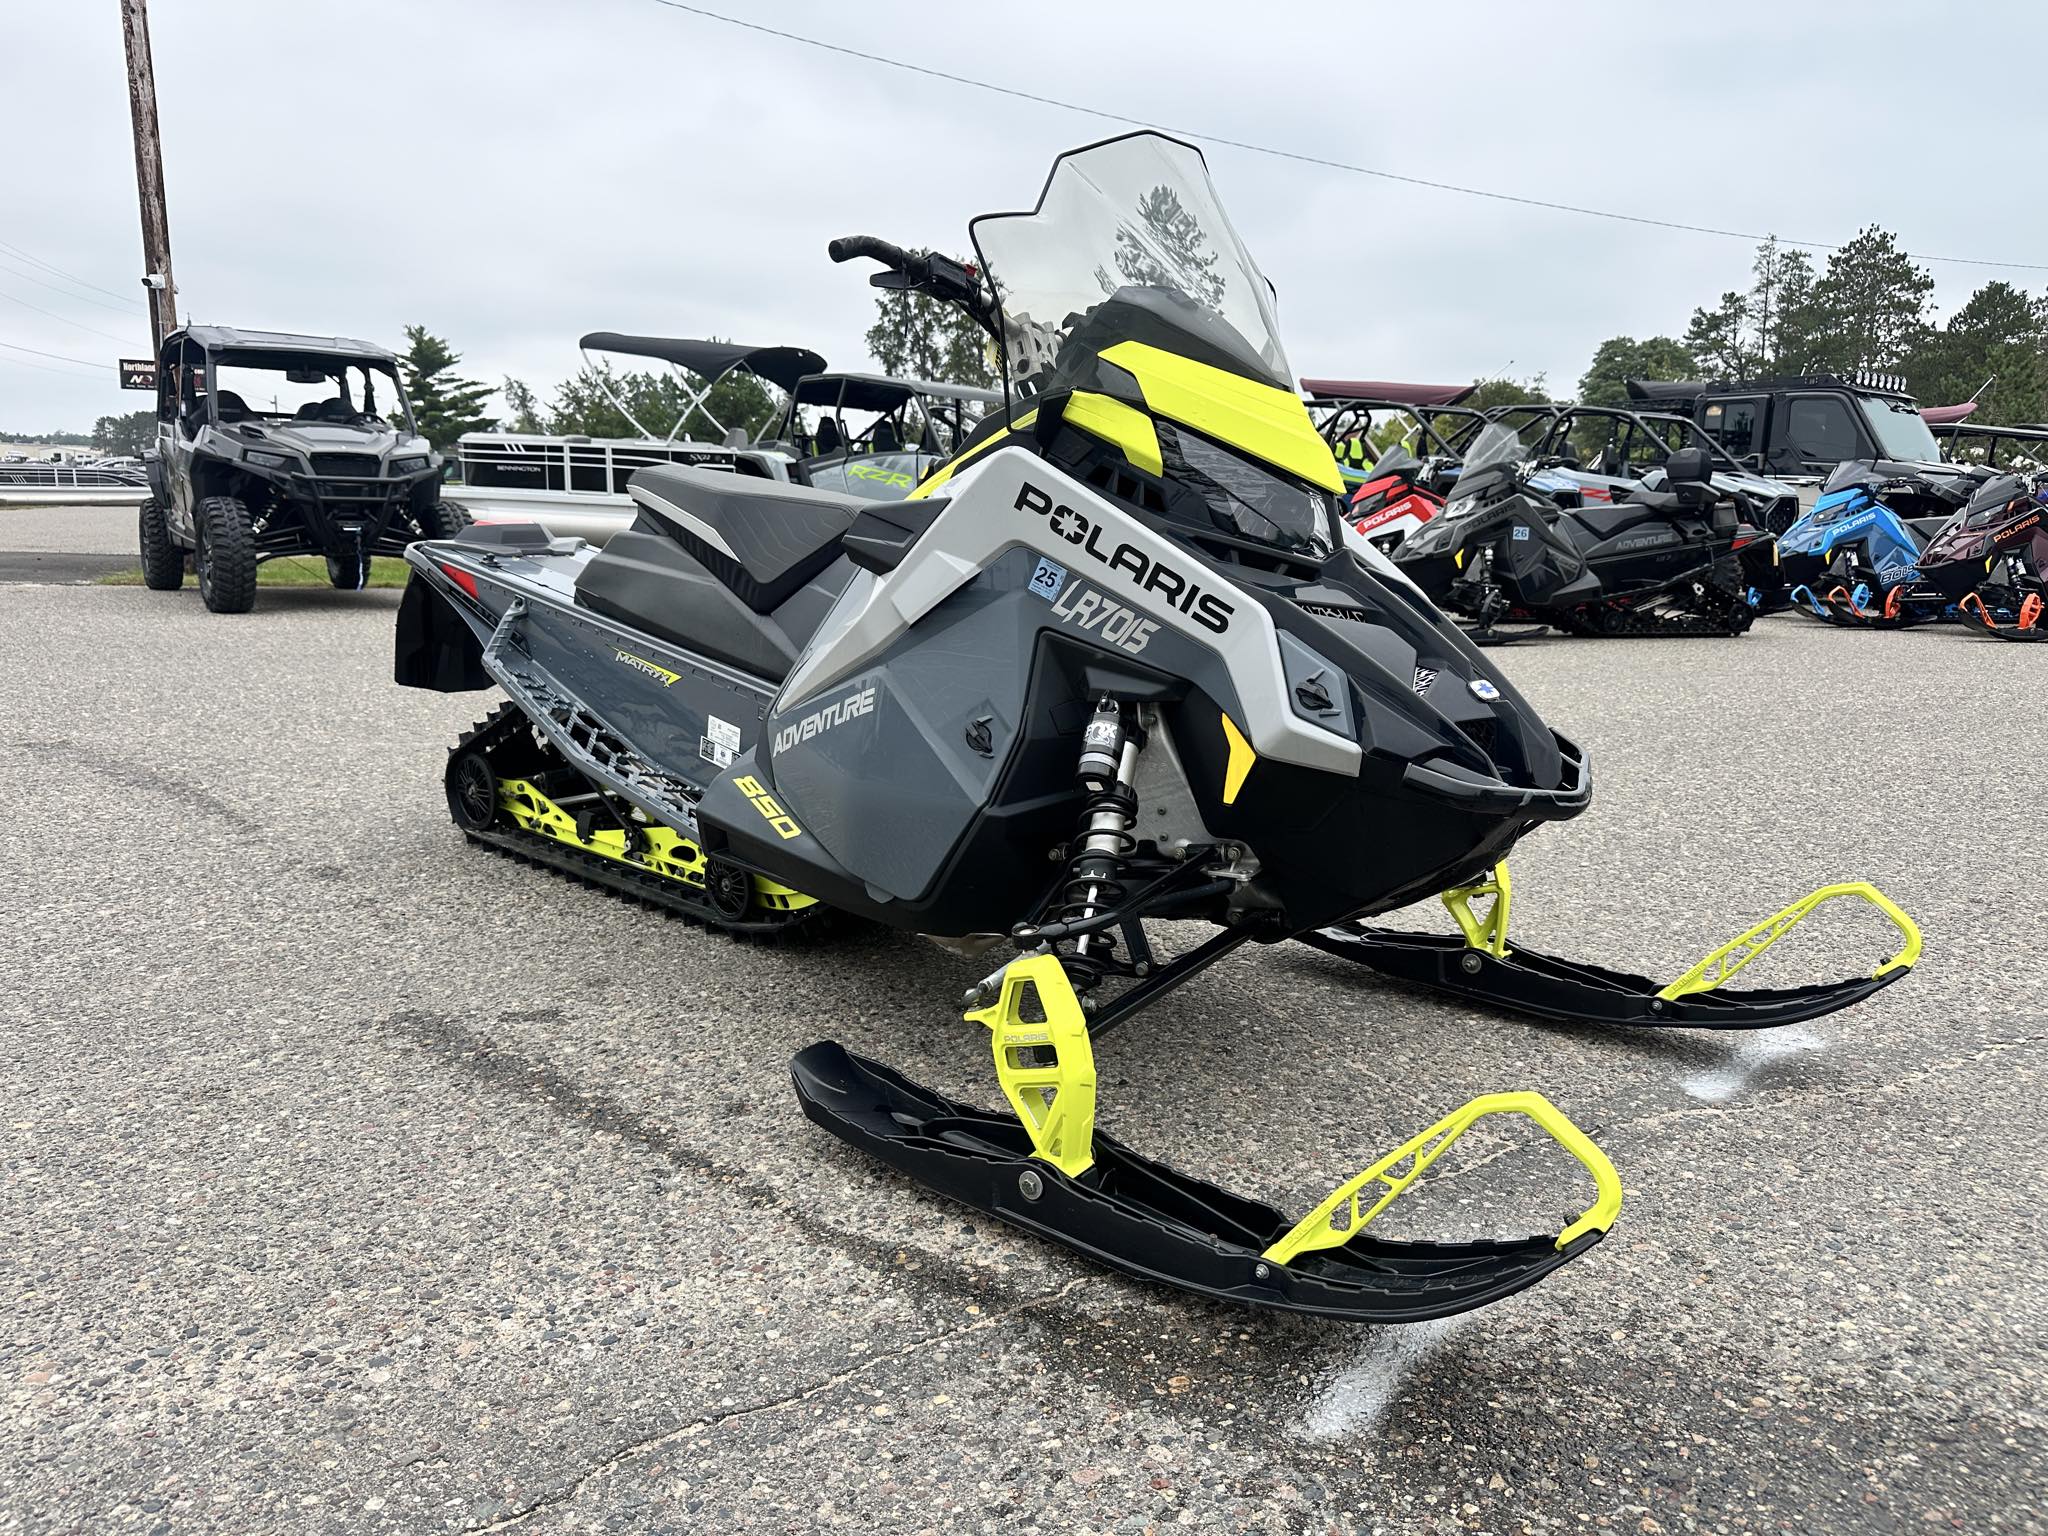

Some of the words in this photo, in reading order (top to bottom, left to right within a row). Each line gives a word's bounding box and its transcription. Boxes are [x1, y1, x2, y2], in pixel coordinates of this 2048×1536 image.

[122, 362, 156, 372] Northland
[496, 464, 541, 472] BENNINGTON
[848, 464, 912, 488] RZR
[1363, 501, 1412, 529] POLARIS
[1463, 501, 1517, 533] POLARIS
[1832, 512, 1877, 536] POLARIS
[1513, 528, 1528, 539] 26
[1993, 514, 2040, 543] POLARIS
[1616, 533, 1673, 552] ADVENTURE
[1013, 481, 1235, 634] POLARIS
[1034, 566, 1058, 588] 25
[1050, 578, 1162, 654] LR7015
[615, 651, 670, 688] MATRYX
[772, 687, 876, 758] ADVENTURE
[732, 775, 802, 840] 850
[1003, 1033, 1049, 1042] POLARIS
